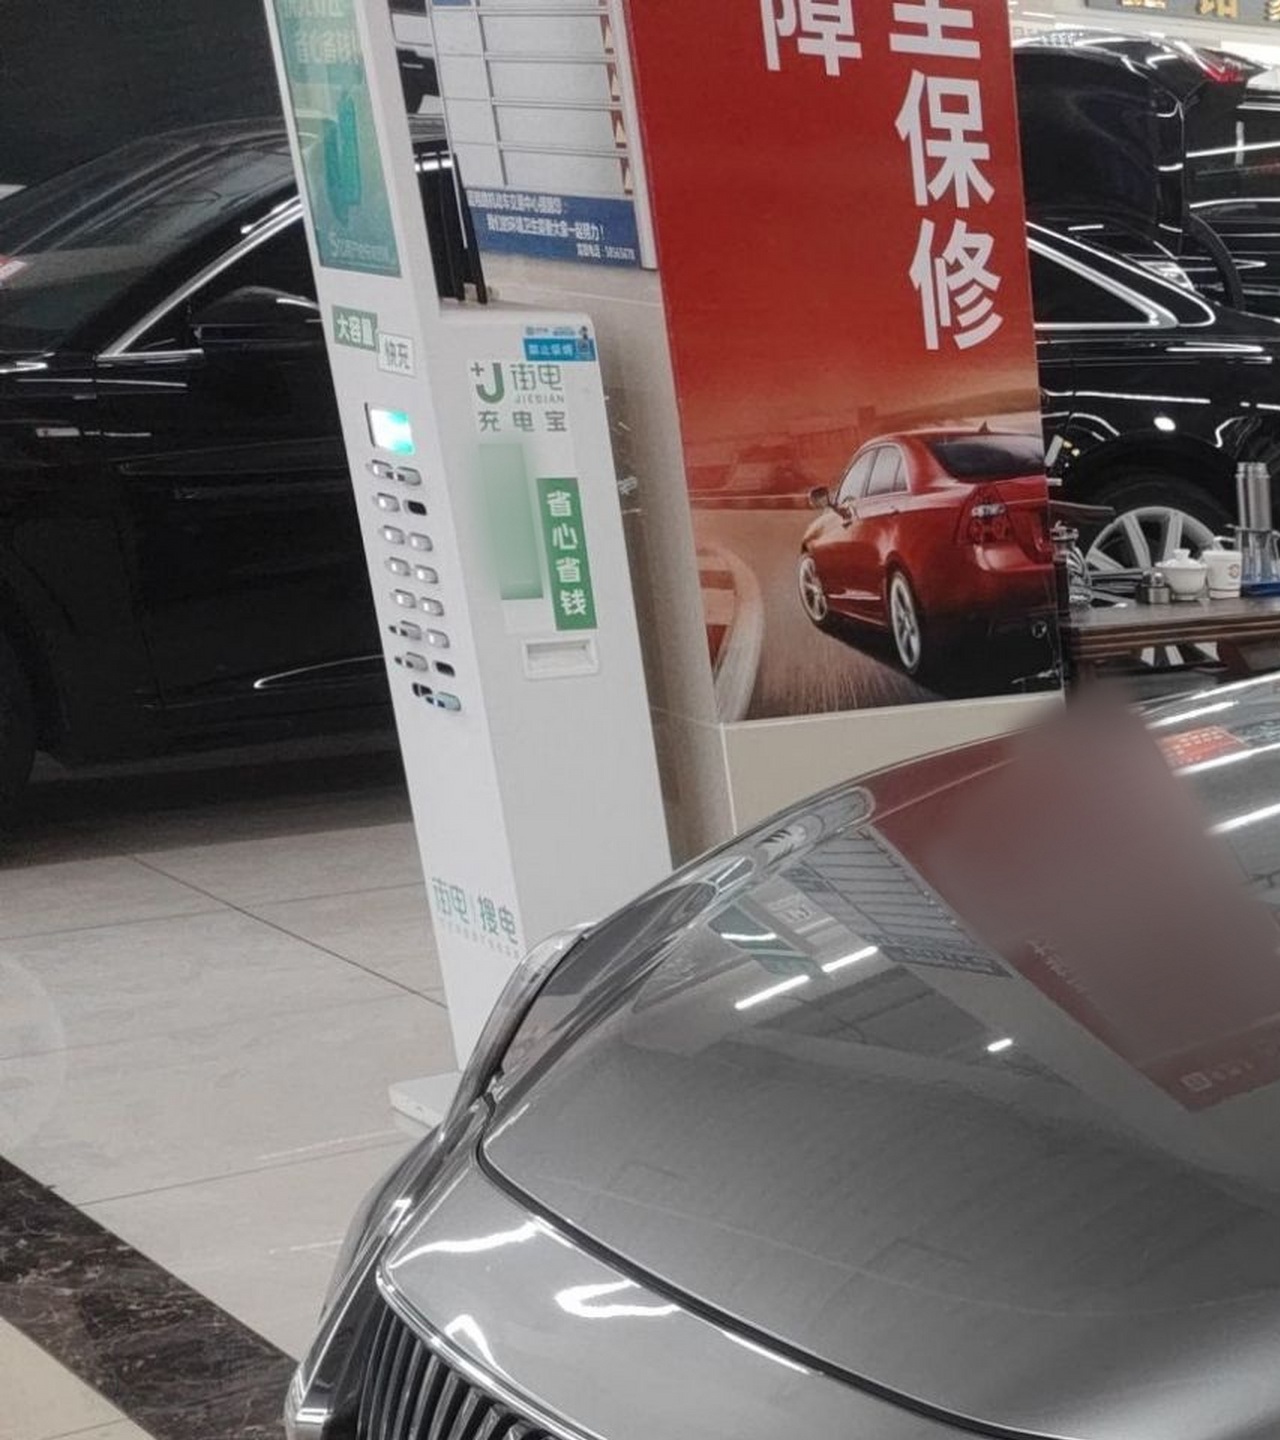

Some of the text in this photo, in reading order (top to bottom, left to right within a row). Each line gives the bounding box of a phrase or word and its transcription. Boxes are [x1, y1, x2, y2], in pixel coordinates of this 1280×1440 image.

[336, 313, 375, 347] 大容量
[509, 363, 563, 391] 街电
[478, 410, 568, 432] 充电宝
[547, 490, 588, 616] 省心省钱
